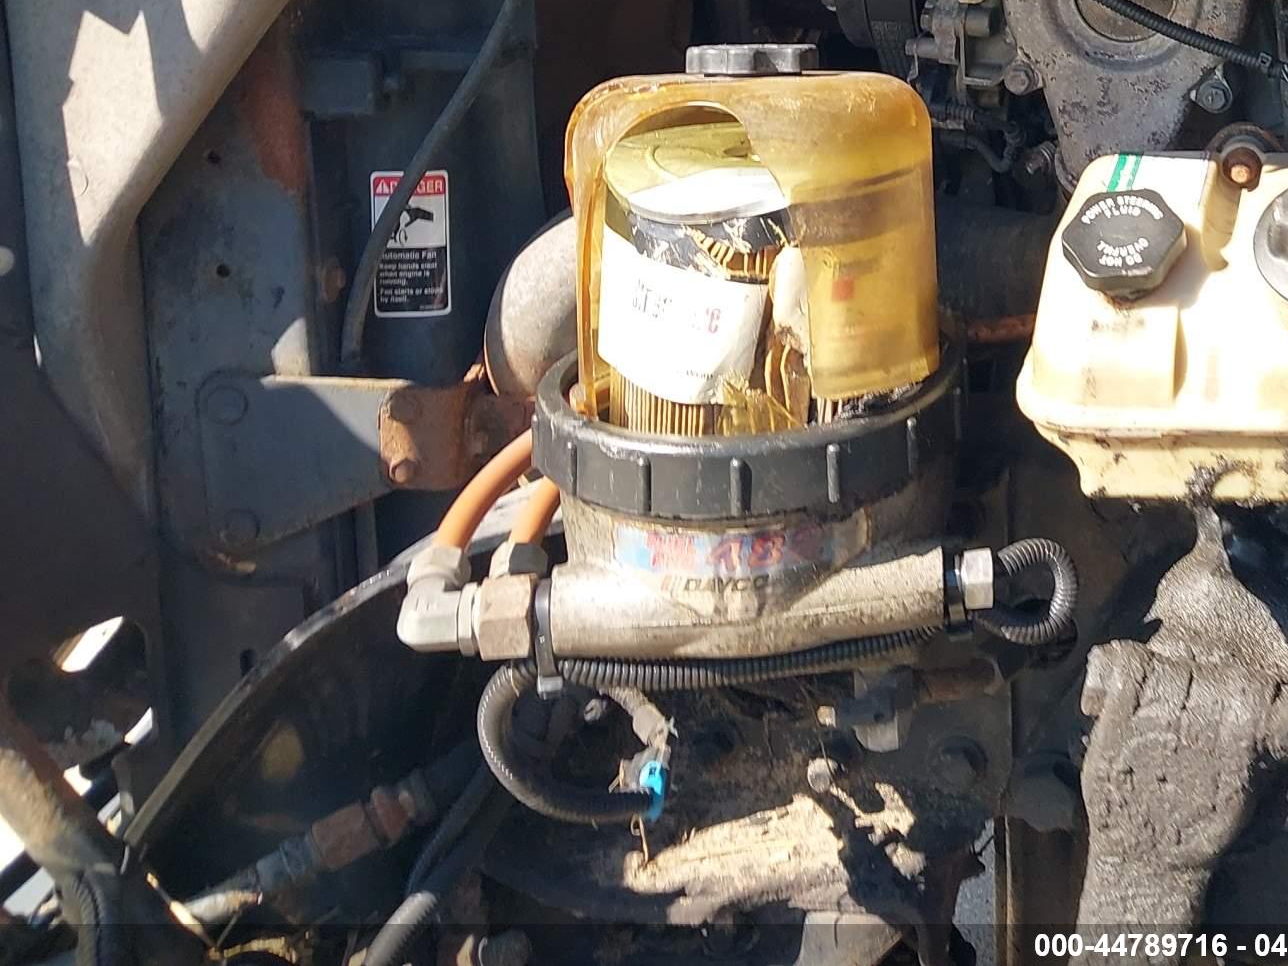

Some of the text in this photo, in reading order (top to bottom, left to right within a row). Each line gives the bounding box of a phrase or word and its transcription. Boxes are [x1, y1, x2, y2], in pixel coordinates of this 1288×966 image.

[390, 179, 443, 194] DGER
[1081, 195, 1164, 225] POWER STEERING
[1103, 205, 1141, 219] FLUID
[1096, 237, 1150, 257] OVERFILL
[421, 251, 437, 260] Fan
[1099, 253, 1143, 267] DO NOT
[398, 262, 419, 270] hands
